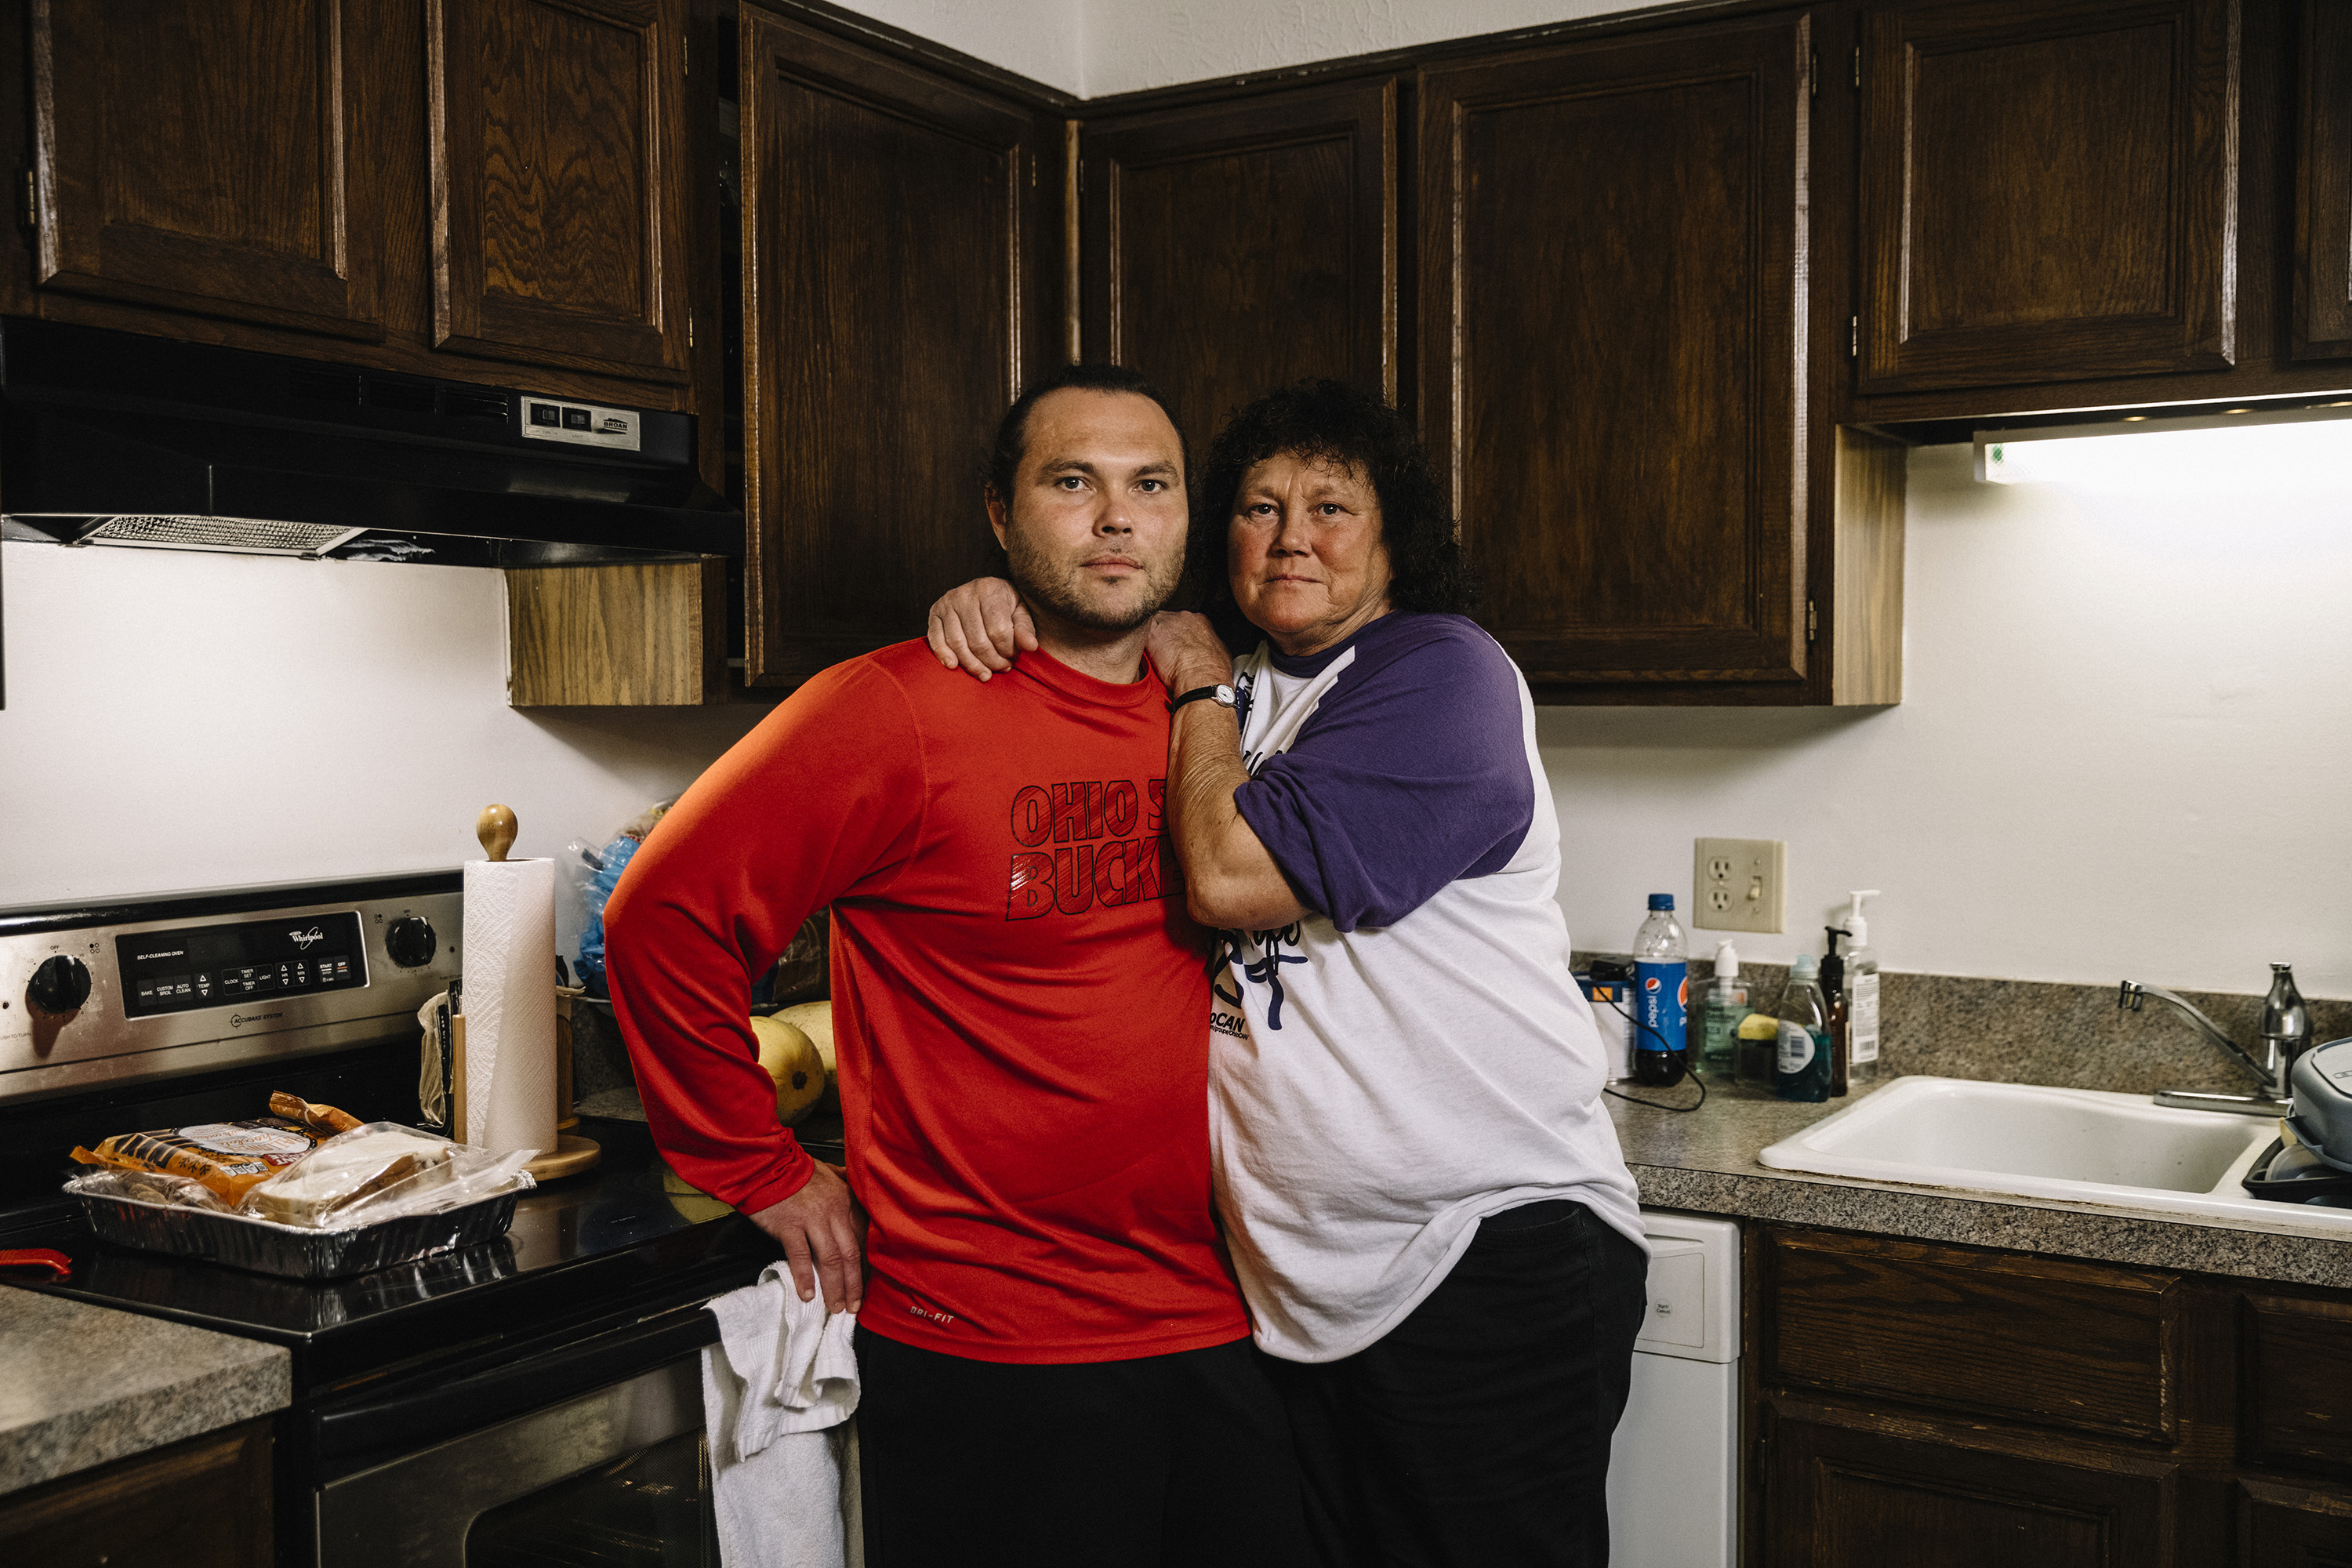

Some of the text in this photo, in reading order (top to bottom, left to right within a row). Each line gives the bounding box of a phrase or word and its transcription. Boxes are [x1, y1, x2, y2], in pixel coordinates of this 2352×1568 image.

[1011, 780, 1138, 848] OHIO
[292, 931, 324, 942] Whirlpool
[137, 951, 172, 960] SELF-CLEANING
[234, 1014, 262, 1024] ACCUBAKE
[1647, 995, 1660, 1028] pepsi
[1210, 1012, 1246, 1033] oCAN
[910, 1306, 955, 1323] DRI-FIT
